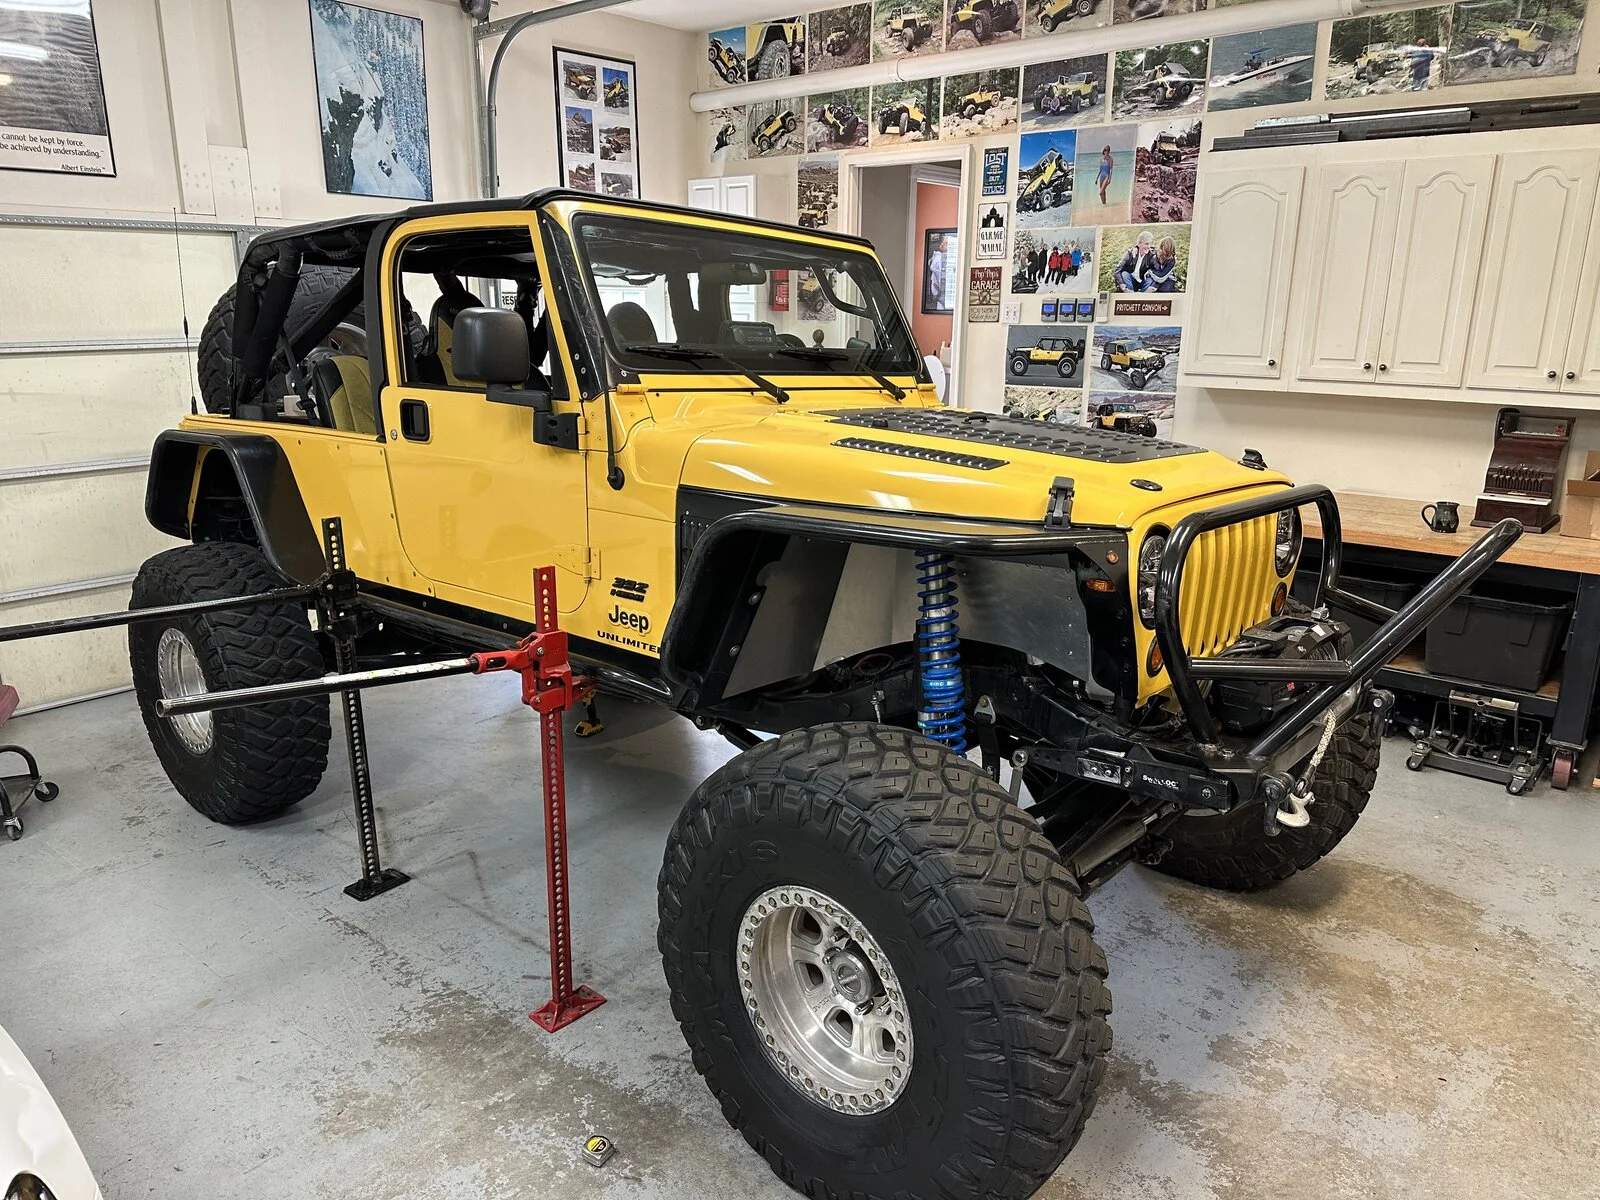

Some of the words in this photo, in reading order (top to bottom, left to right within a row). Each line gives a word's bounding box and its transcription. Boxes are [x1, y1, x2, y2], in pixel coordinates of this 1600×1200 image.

[1, 133, 26, 141] cannot
[28, 134, 38, 142] be
[39, 135, 56, 145] kept
[56, 137, 65, 146] by
[66, 138, 85, 147] force.
[0, 142, 9, 150] be
[10, 143, 42, 153] achieved
[43, 145, 52, 155] by
[985, 153, 1007, 168] LOST
[983, 185, 1005, 194] STUCK
[980, 231, 1004, 241] GARAGE
[980, 243, 1003, 253] MAHAL
[971, 280, 1000, 291] GARAGE
[1116, 303, 1141, 312] PRITCHETT
[1141, 303, 1163, 312] CANYON
[608, 604, 649, 634] Jeep
